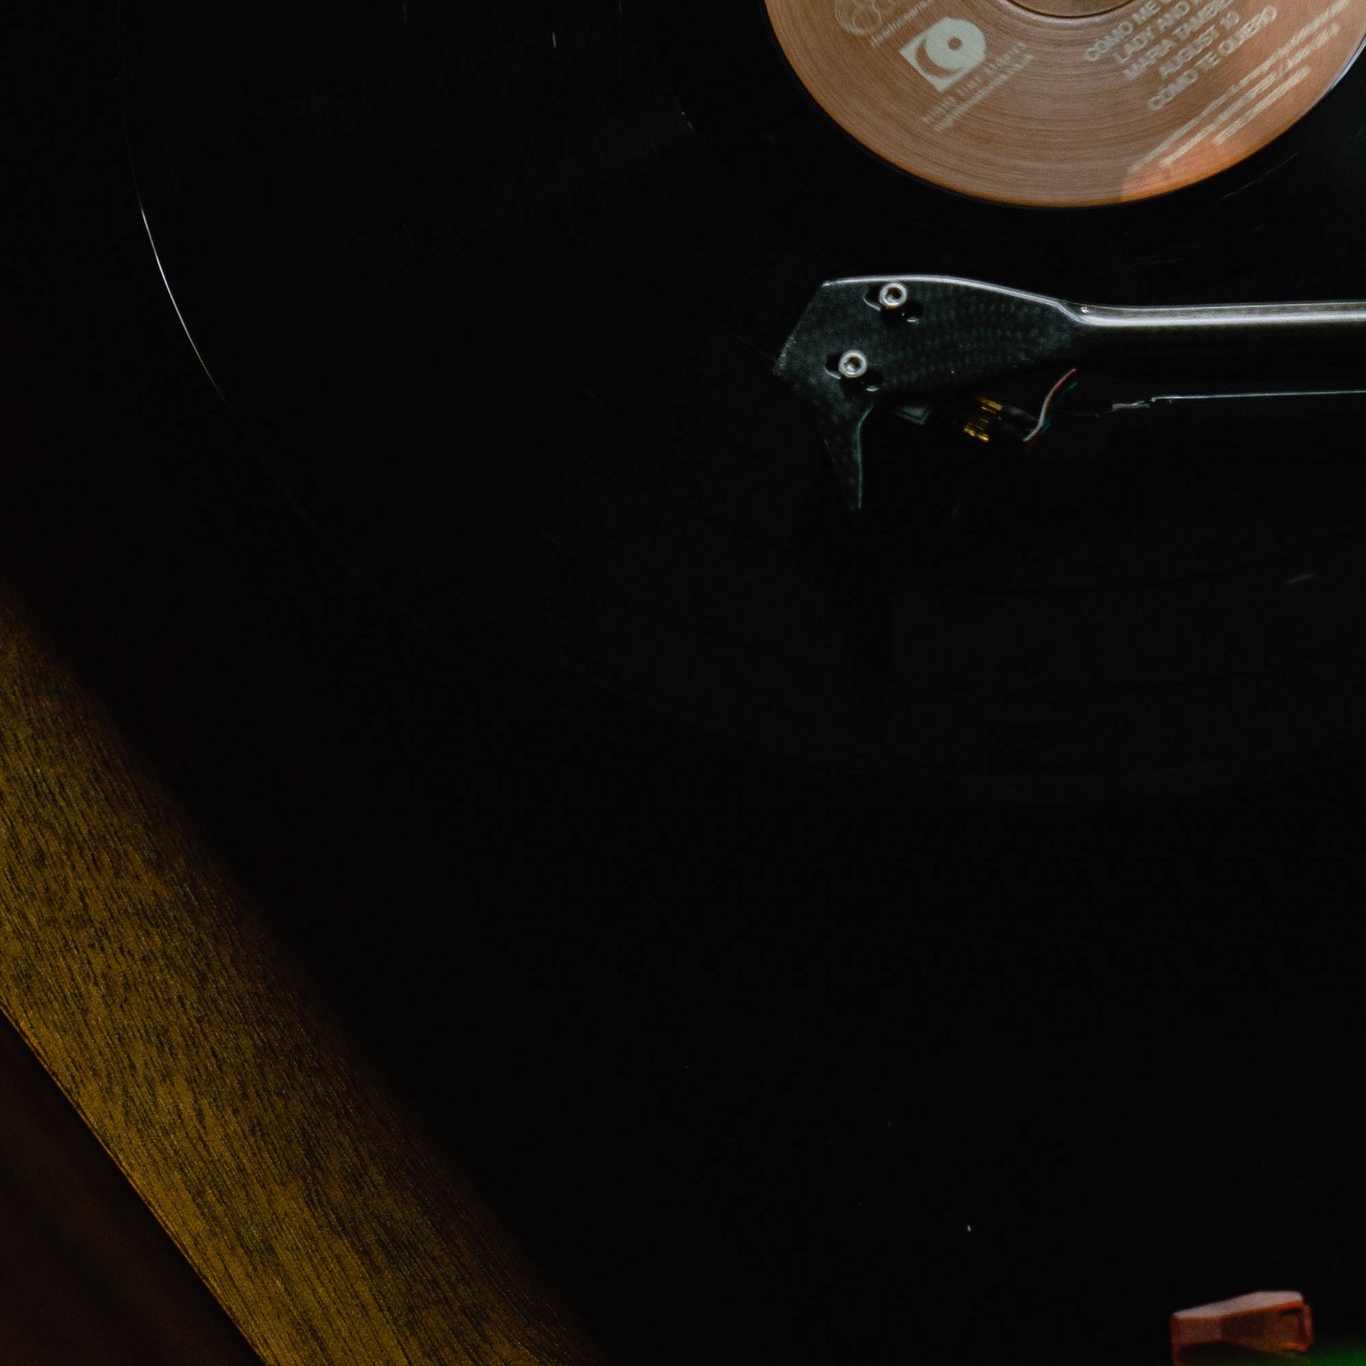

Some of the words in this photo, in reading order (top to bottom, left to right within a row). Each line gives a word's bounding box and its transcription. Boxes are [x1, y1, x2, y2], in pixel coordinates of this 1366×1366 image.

[1113, 26, 1154, 64] LADY
[1156, 2, 1189, 32] AND
[1132, 0, 1160, 24] ME
[1194, 52, 1222, 72] TE
[1218, 5, 1277, 55] QUIERO
[1159, 25, 1219, 78] AUGUST
[1220, 11, 1239, 29] 10
